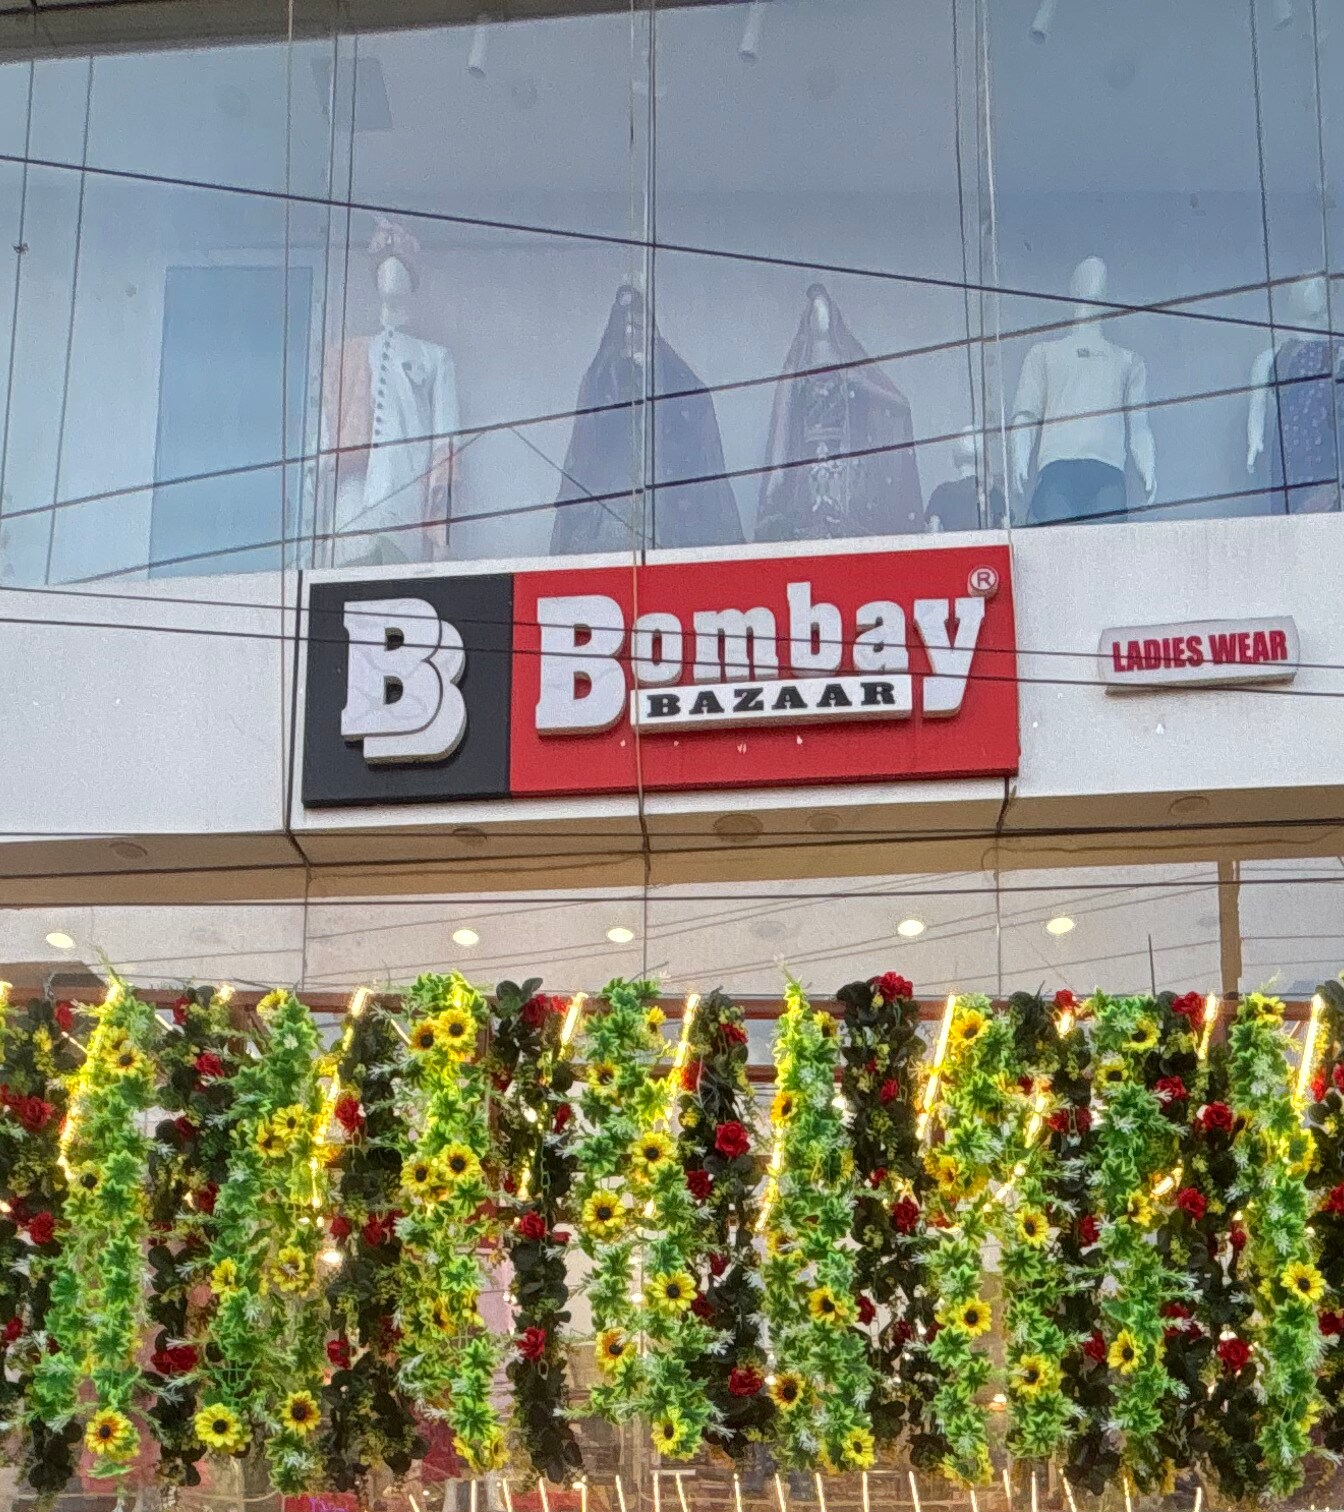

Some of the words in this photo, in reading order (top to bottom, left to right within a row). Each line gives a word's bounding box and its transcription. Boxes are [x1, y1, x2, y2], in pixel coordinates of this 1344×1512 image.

[1112, 635, 1204, 673] LADIES
[1208, 629, 1289, 665] WEAR
[646, 681, 897, 719] BAZAAR
